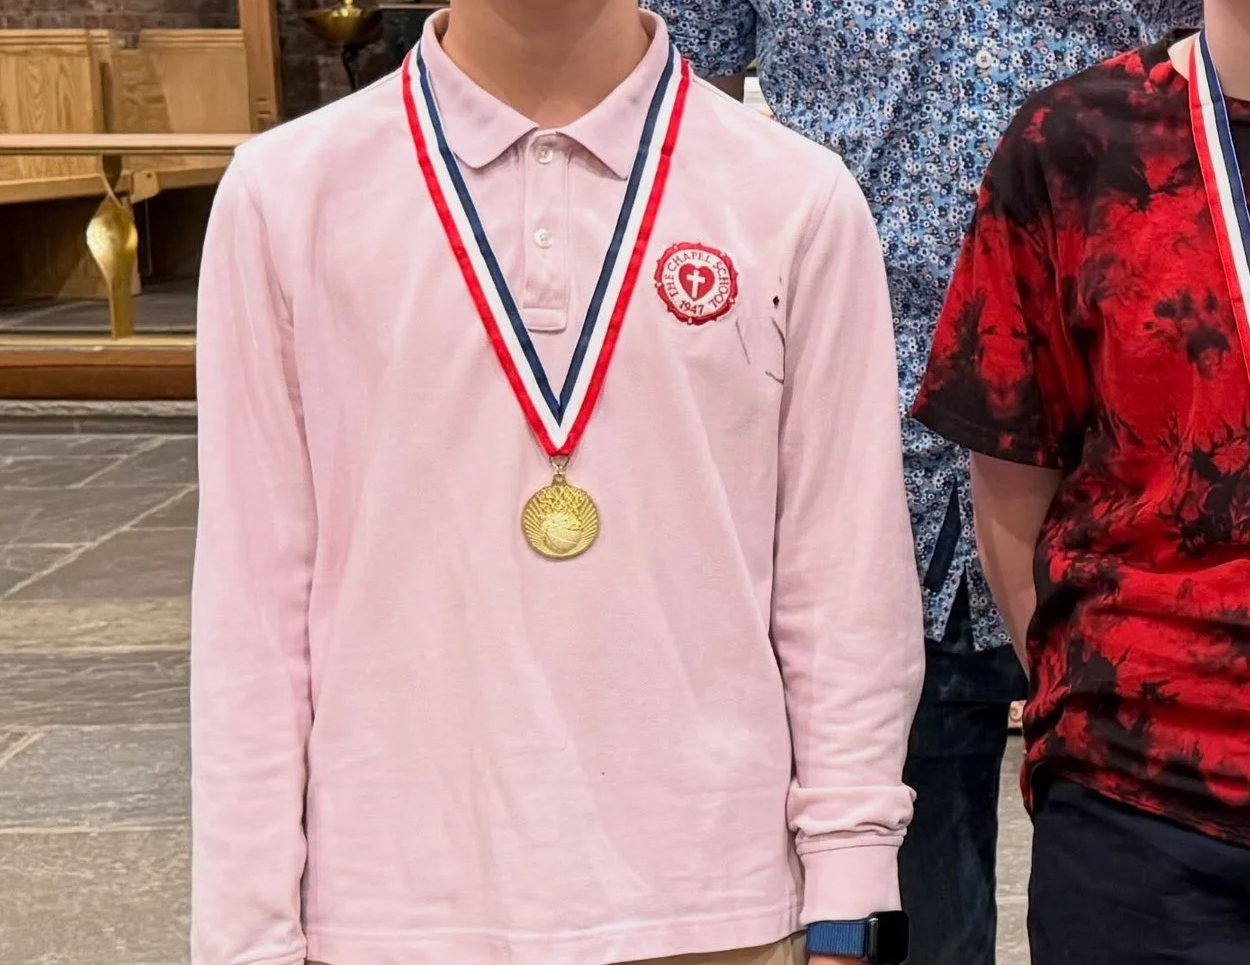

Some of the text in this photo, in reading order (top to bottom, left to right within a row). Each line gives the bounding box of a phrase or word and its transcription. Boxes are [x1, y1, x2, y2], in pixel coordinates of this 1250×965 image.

[664, 251, 729, 308] THE CHAPEL SCHOOL
[679, 300, 705, 315] 1947
